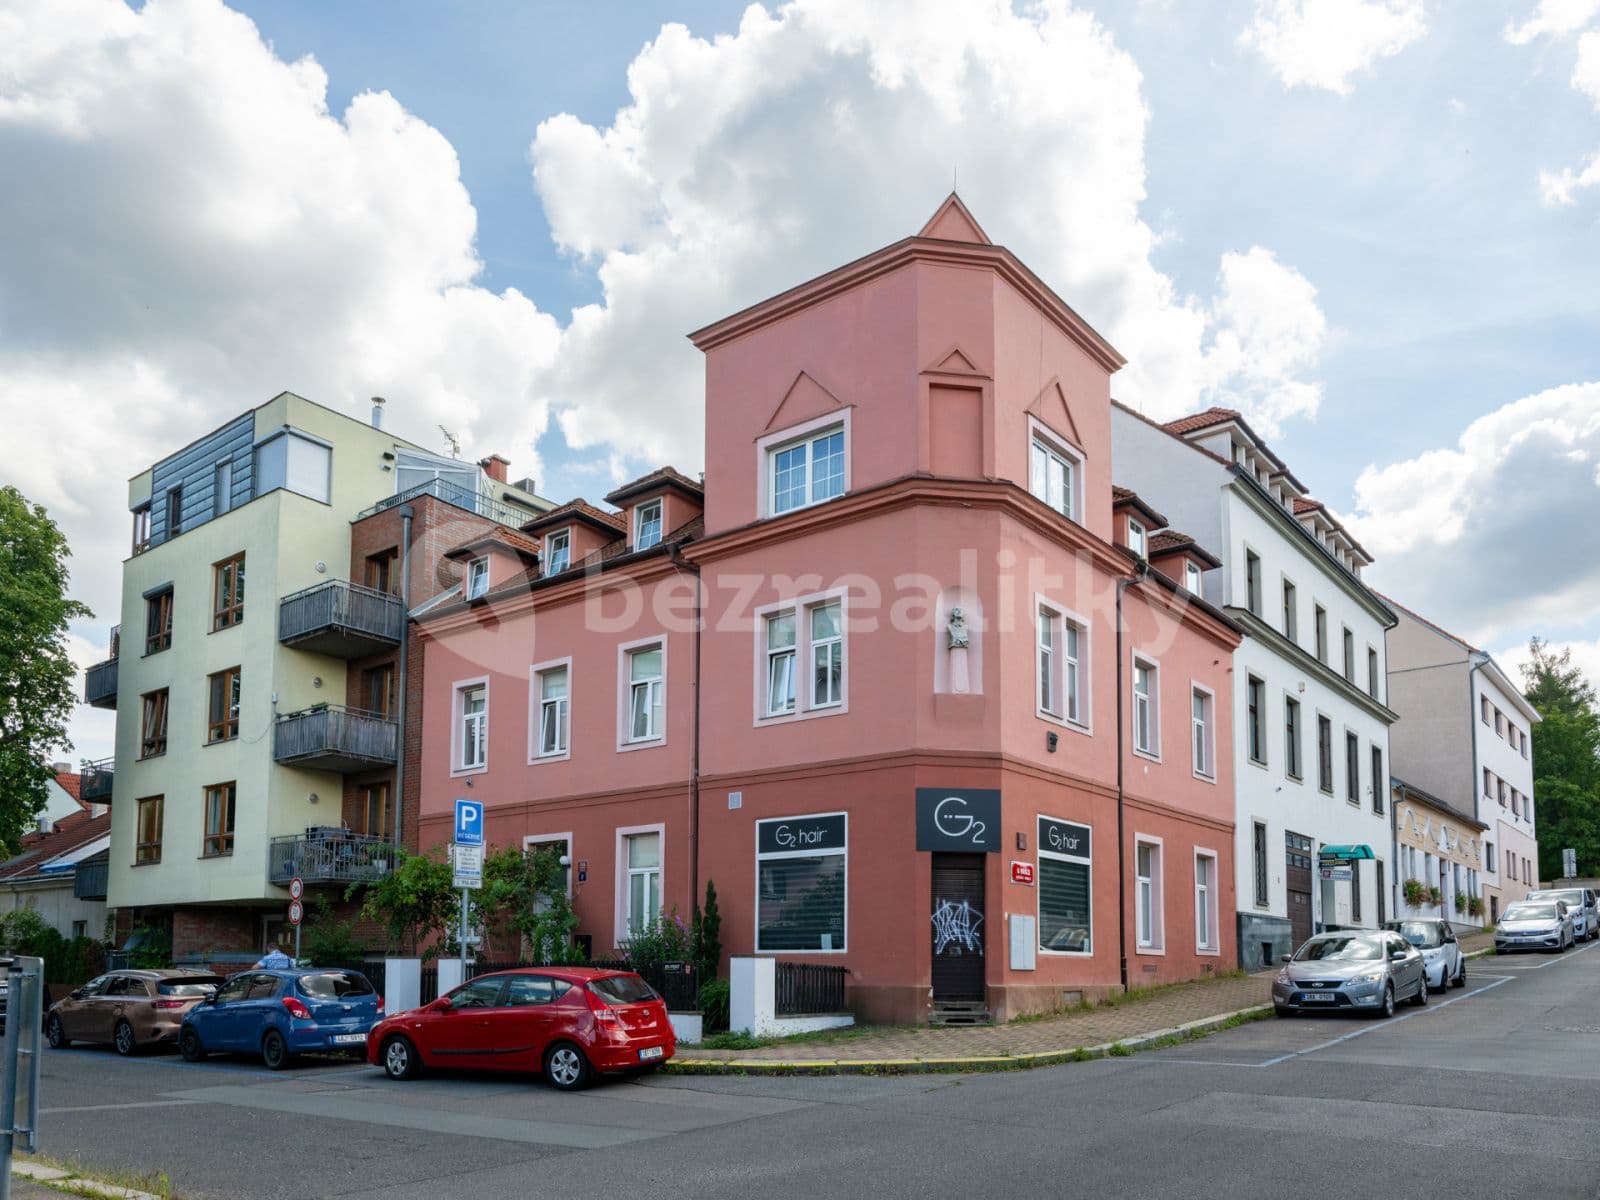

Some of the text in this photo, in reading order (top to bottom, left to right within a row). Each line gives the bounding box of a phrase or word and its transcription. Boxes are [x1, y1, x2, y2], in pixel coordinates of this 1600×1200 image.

[461, 805, 477, 830] P
[799, 826, 826, 844] hair
[1063, 832, 1081, 850] hair
